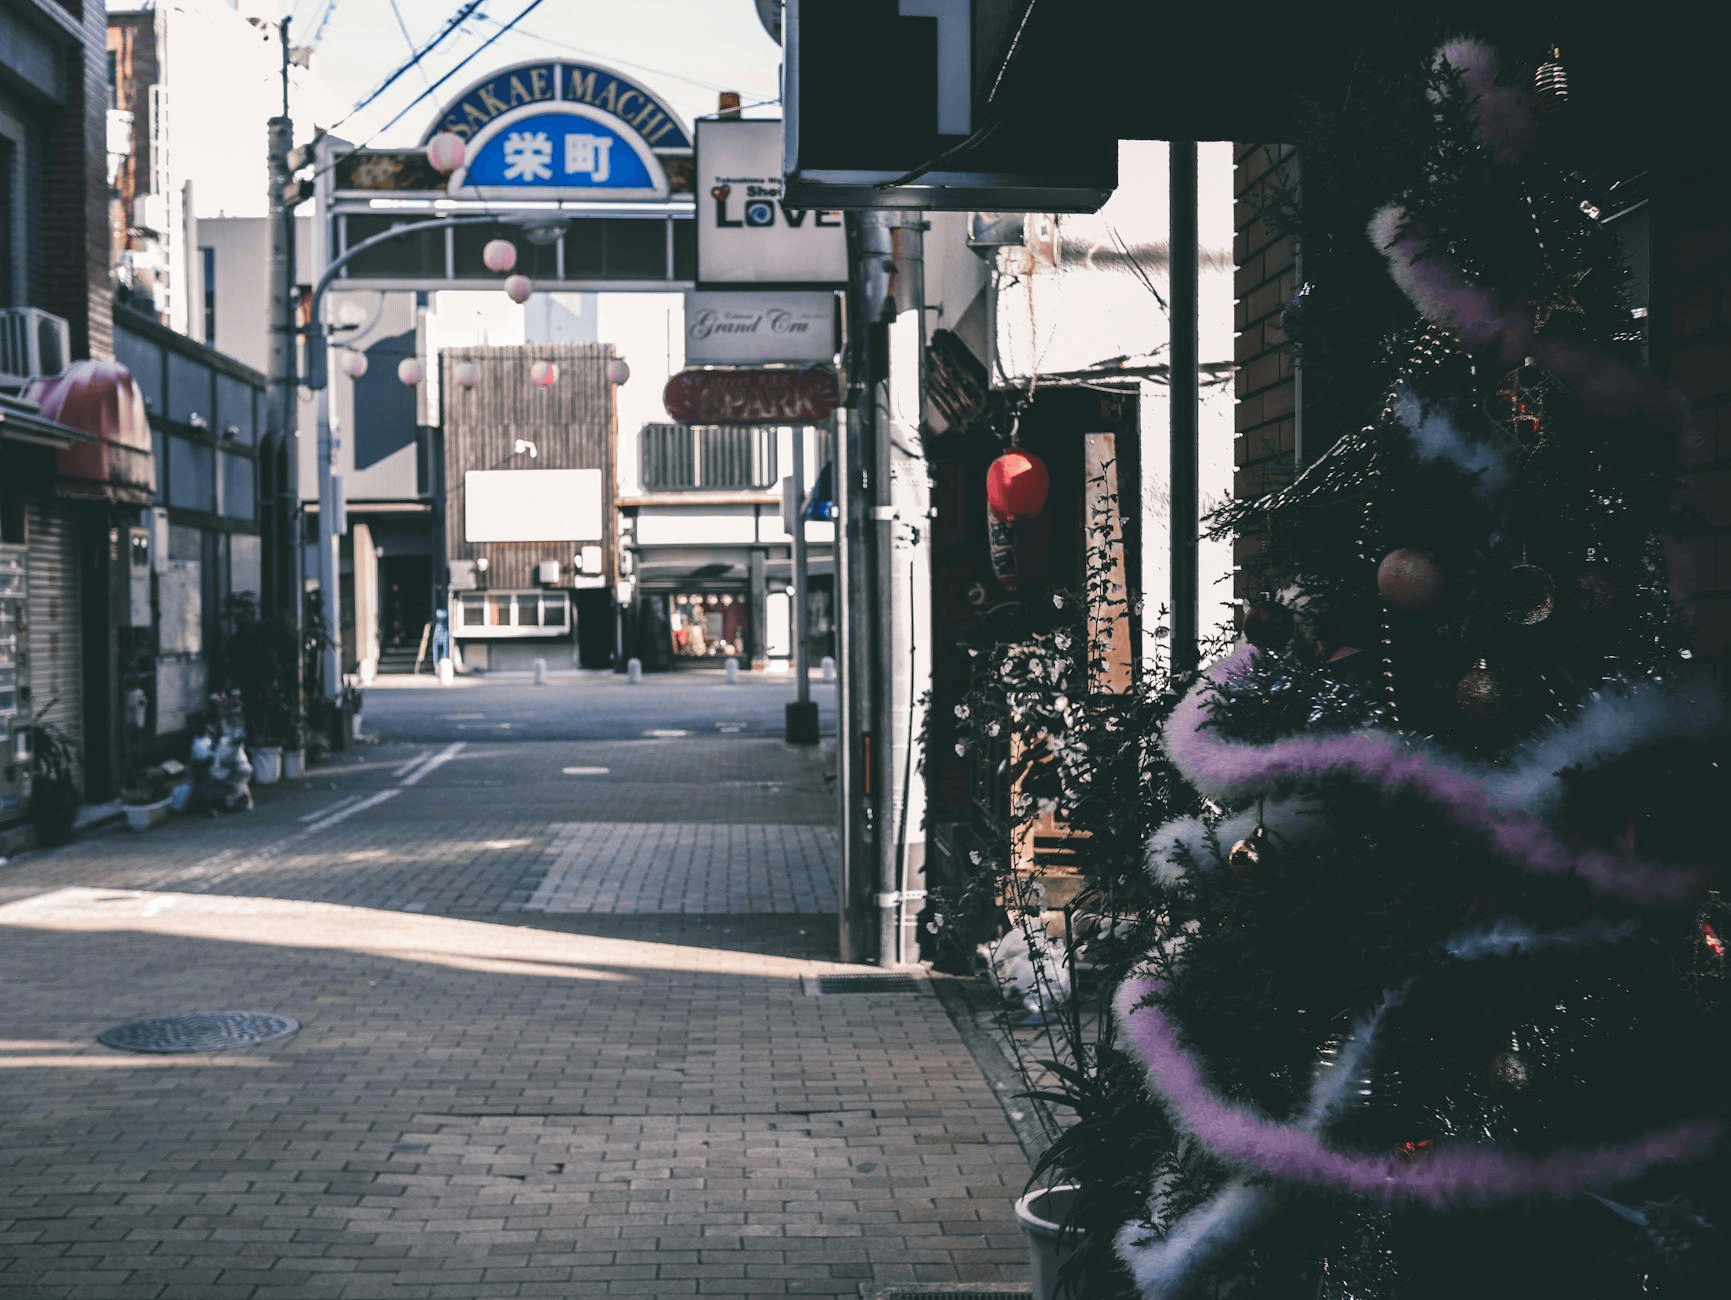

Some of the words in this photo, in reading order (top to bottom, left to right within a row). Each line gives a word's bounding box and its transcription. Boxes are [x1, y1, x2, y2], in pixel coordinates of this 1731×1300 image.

[445, 67, 552, 138] SAKAE
[569, 68, 674, 143] MACHI
[503, 131, 614, 182] 栄町
[715, 197, 841, 228] LOVE
[689, 308, 762, 340] Grand
[766, 308, 809, 333] Cru
